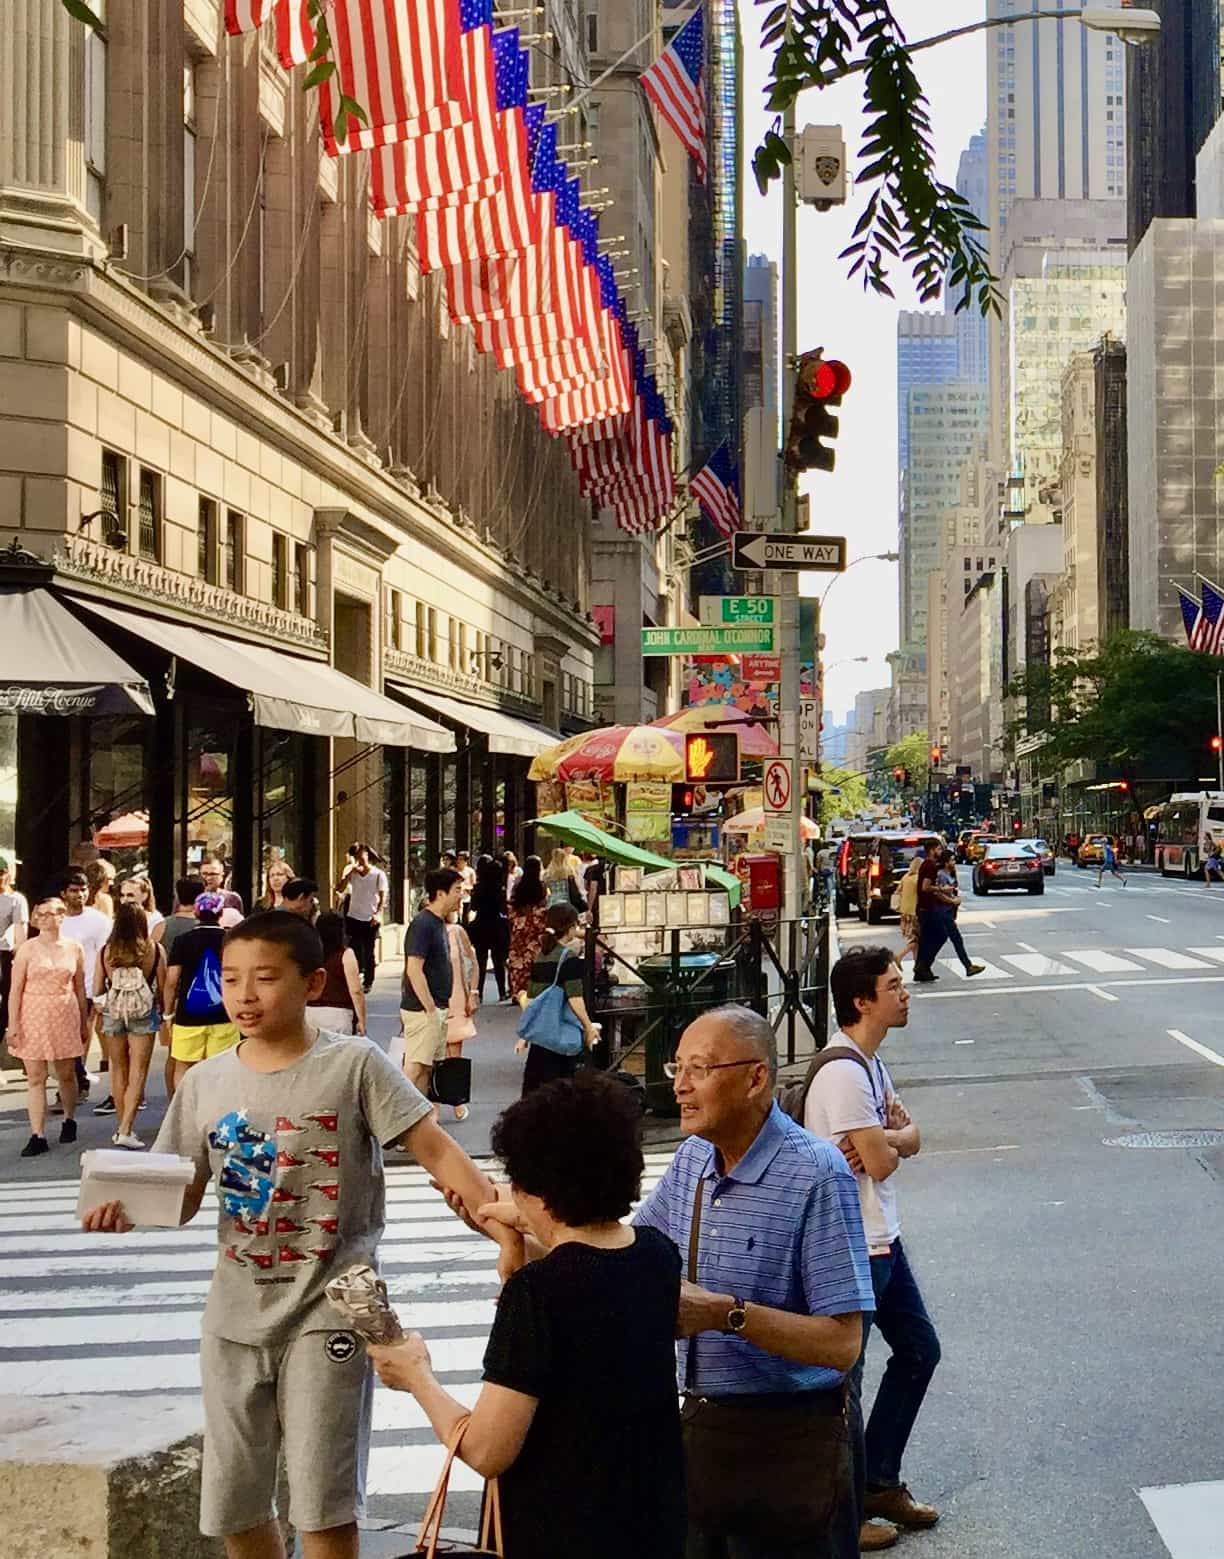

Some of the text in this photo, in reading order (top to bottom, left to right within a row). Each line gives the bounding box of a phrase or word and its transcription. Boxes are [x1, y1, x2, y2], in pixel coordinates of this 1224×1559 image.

[764, 545, 834, 560] ONE WAY
[730, 600, 768, 614] E 50
[644, 629, 771, 646] JOHN CARDINAL O'CONNOR
[44, 686, 97, 710] Avenue
